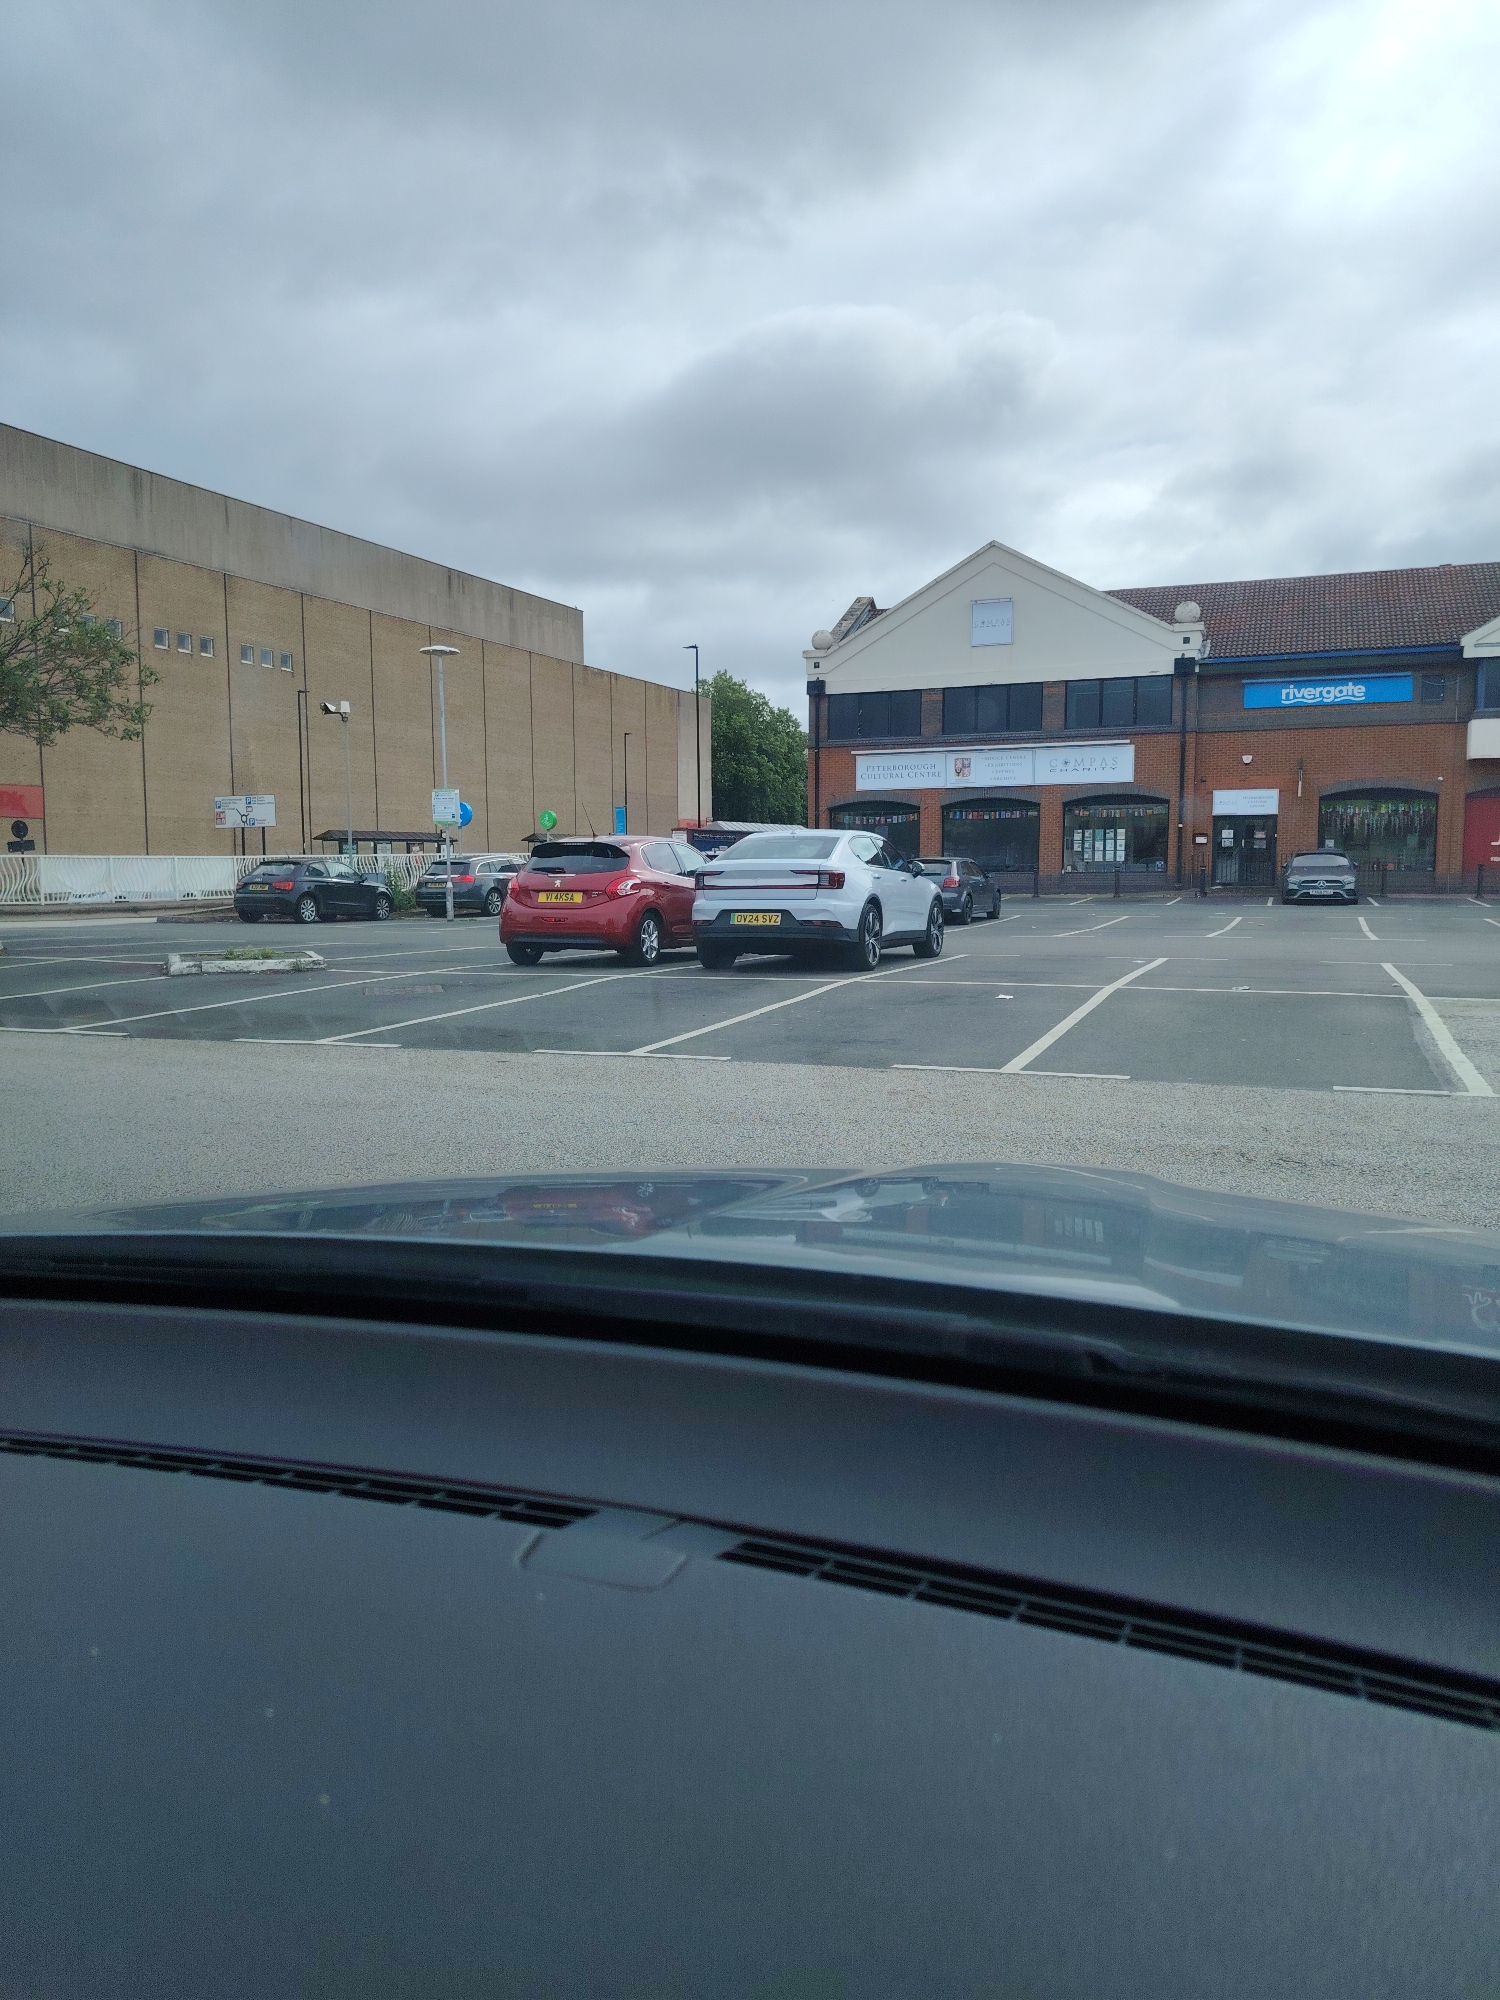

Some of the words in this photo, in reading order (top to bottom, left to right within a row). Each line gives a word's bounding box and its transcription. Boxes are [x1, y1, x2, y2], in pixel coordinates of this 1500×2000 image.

[1281, 682, 1366, 702] rivergate
[866, 764, 936, 772] PETERBOROUGH
[860, 772, 904, 780] CULTURAL
[907, 770, 942, 779] CENTRE
[736, 914, 760, 923] OV24
[762, 914, 780, 924] SVZ
